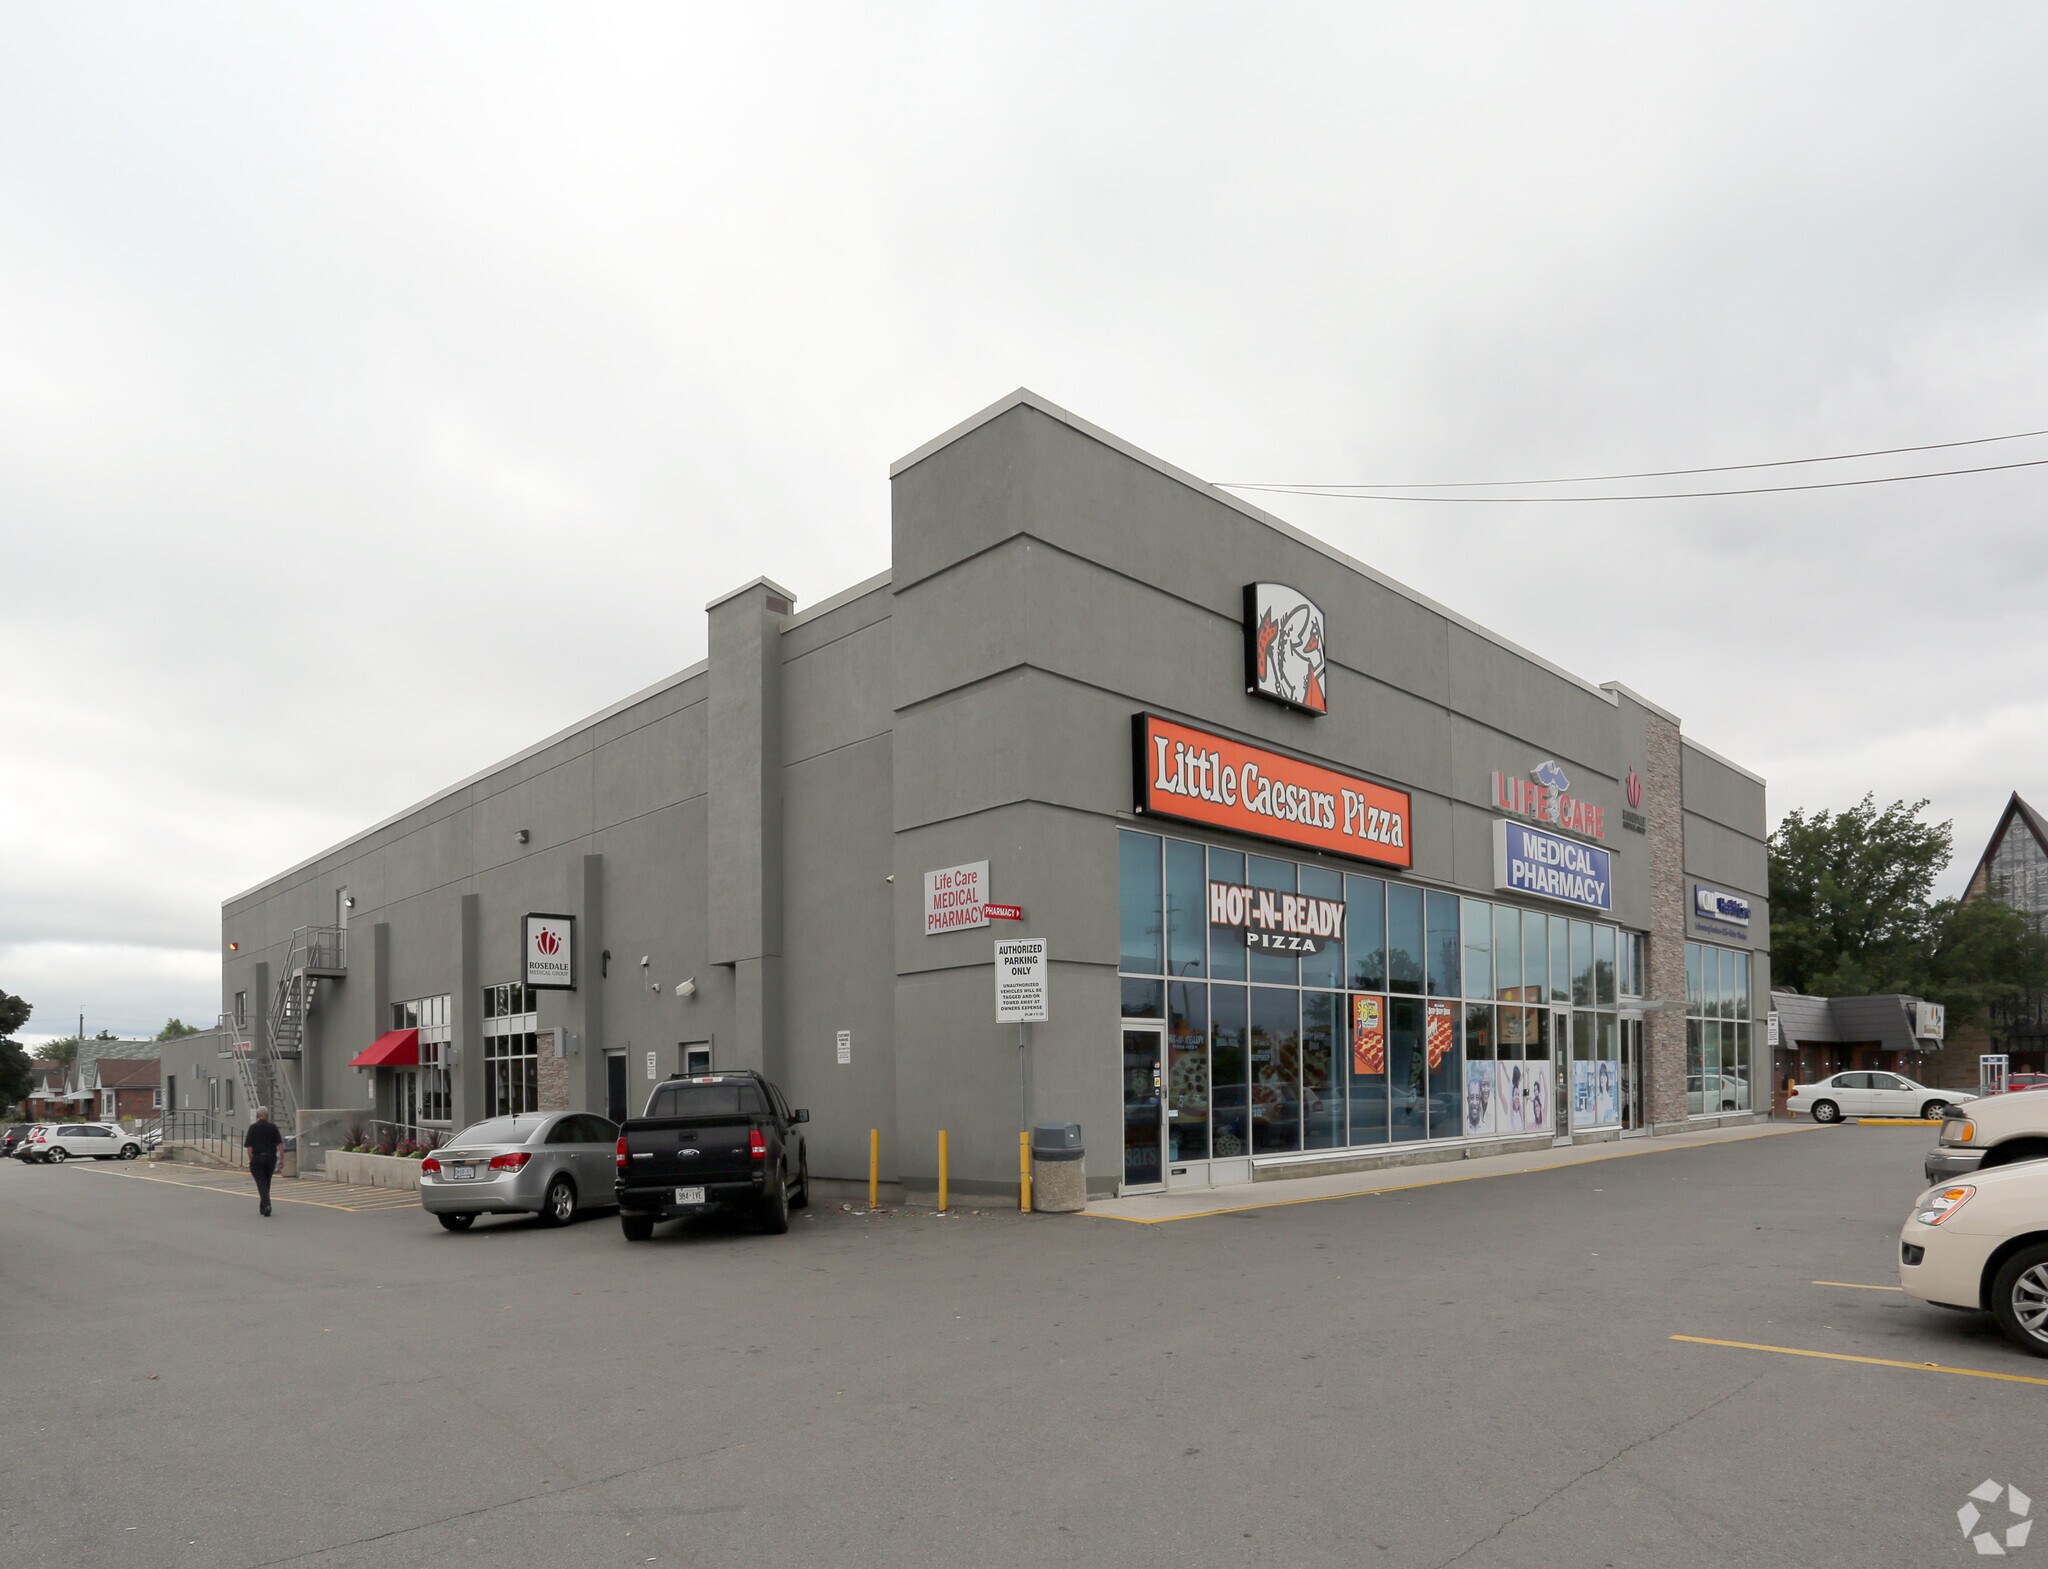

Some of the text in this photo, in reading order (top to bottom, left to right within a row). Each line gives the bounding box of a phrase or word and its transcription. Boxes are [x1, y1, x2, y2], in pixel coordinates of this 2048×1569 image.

[1153, 734, 1405, 848] Little Caesars Pizza
[1496, 770, 1605, 839] LIFE CARE
[1522, 832, 1596, 876] MEDICAL
[934, 870, 978, 890] Life Care
[1511, 858, 1606, 905] PHARMACY
[933, 887, 979, 910] MEDICAL
[928, 905, 986, 930] PHARMACY
[985, 906, 1015, 917] PHARMACY
[1210, 883, 1345, 939] HOT-N-READY
[999, 944, 1042, 955] AUTHORIZED
[1246, 932, 1317, 952] PIZZA
[529, 962, 568, 971] ROSEDALE
[1004, 956, 1038, 965] PARKING
[1011, 966, 1031, 975] ONLY
